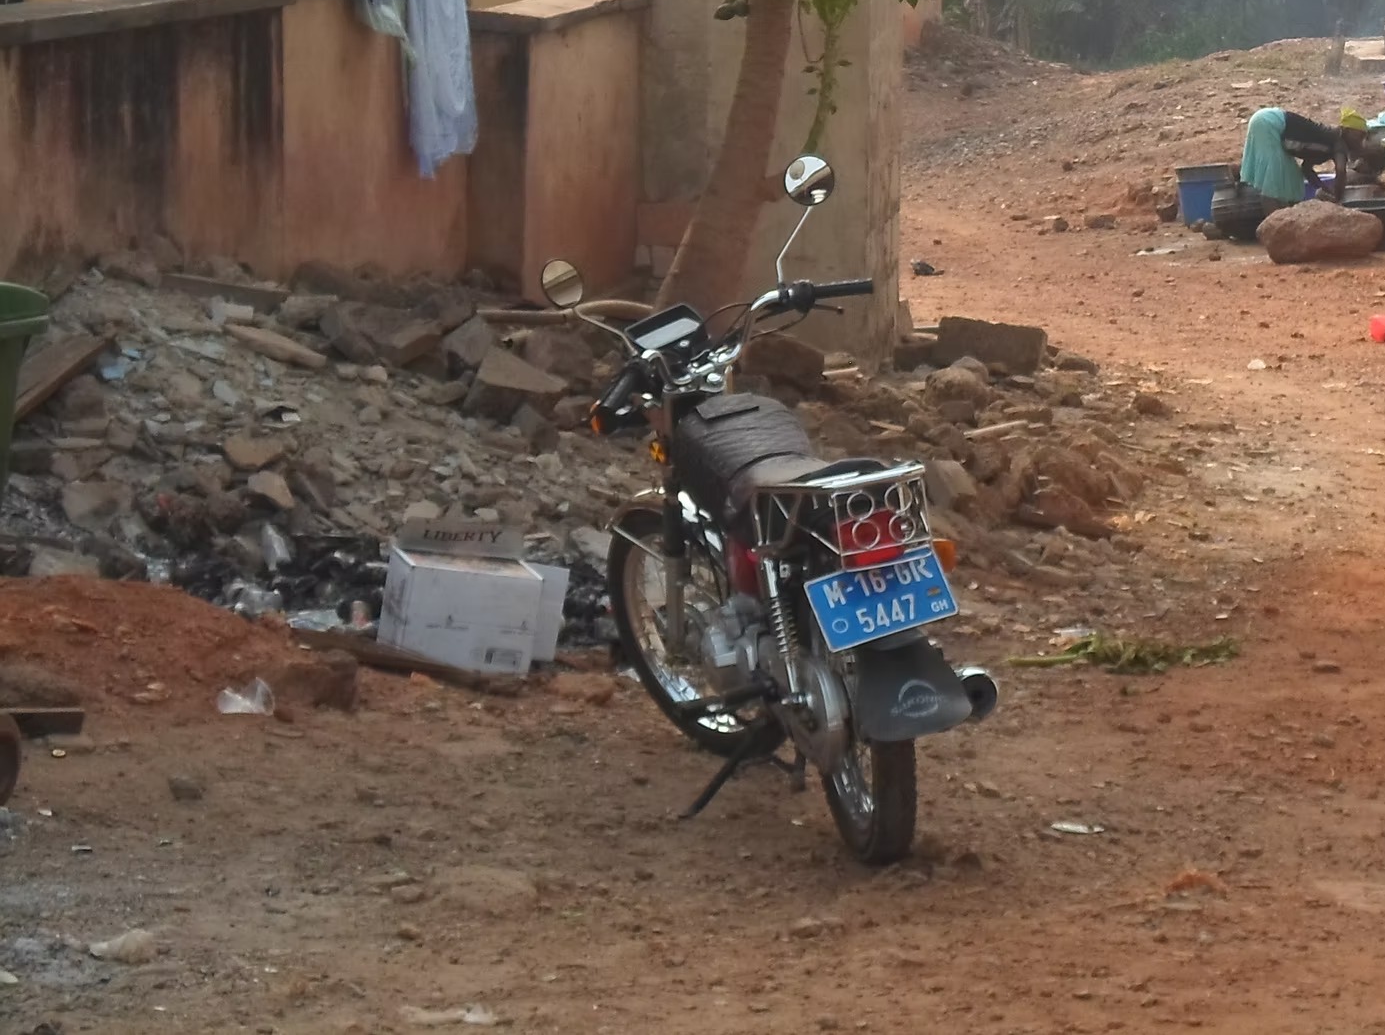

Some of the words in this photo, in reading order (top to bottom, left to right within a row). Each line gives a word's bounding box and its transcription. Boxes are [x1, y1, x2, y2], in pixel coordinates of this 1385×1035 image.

[423, 528, 503, 544] LIBERTY
[822, 557, 934, 609] M-16-GR
[855, 593, 917, 633] 5447
[931, 598, 949, 614] GH
